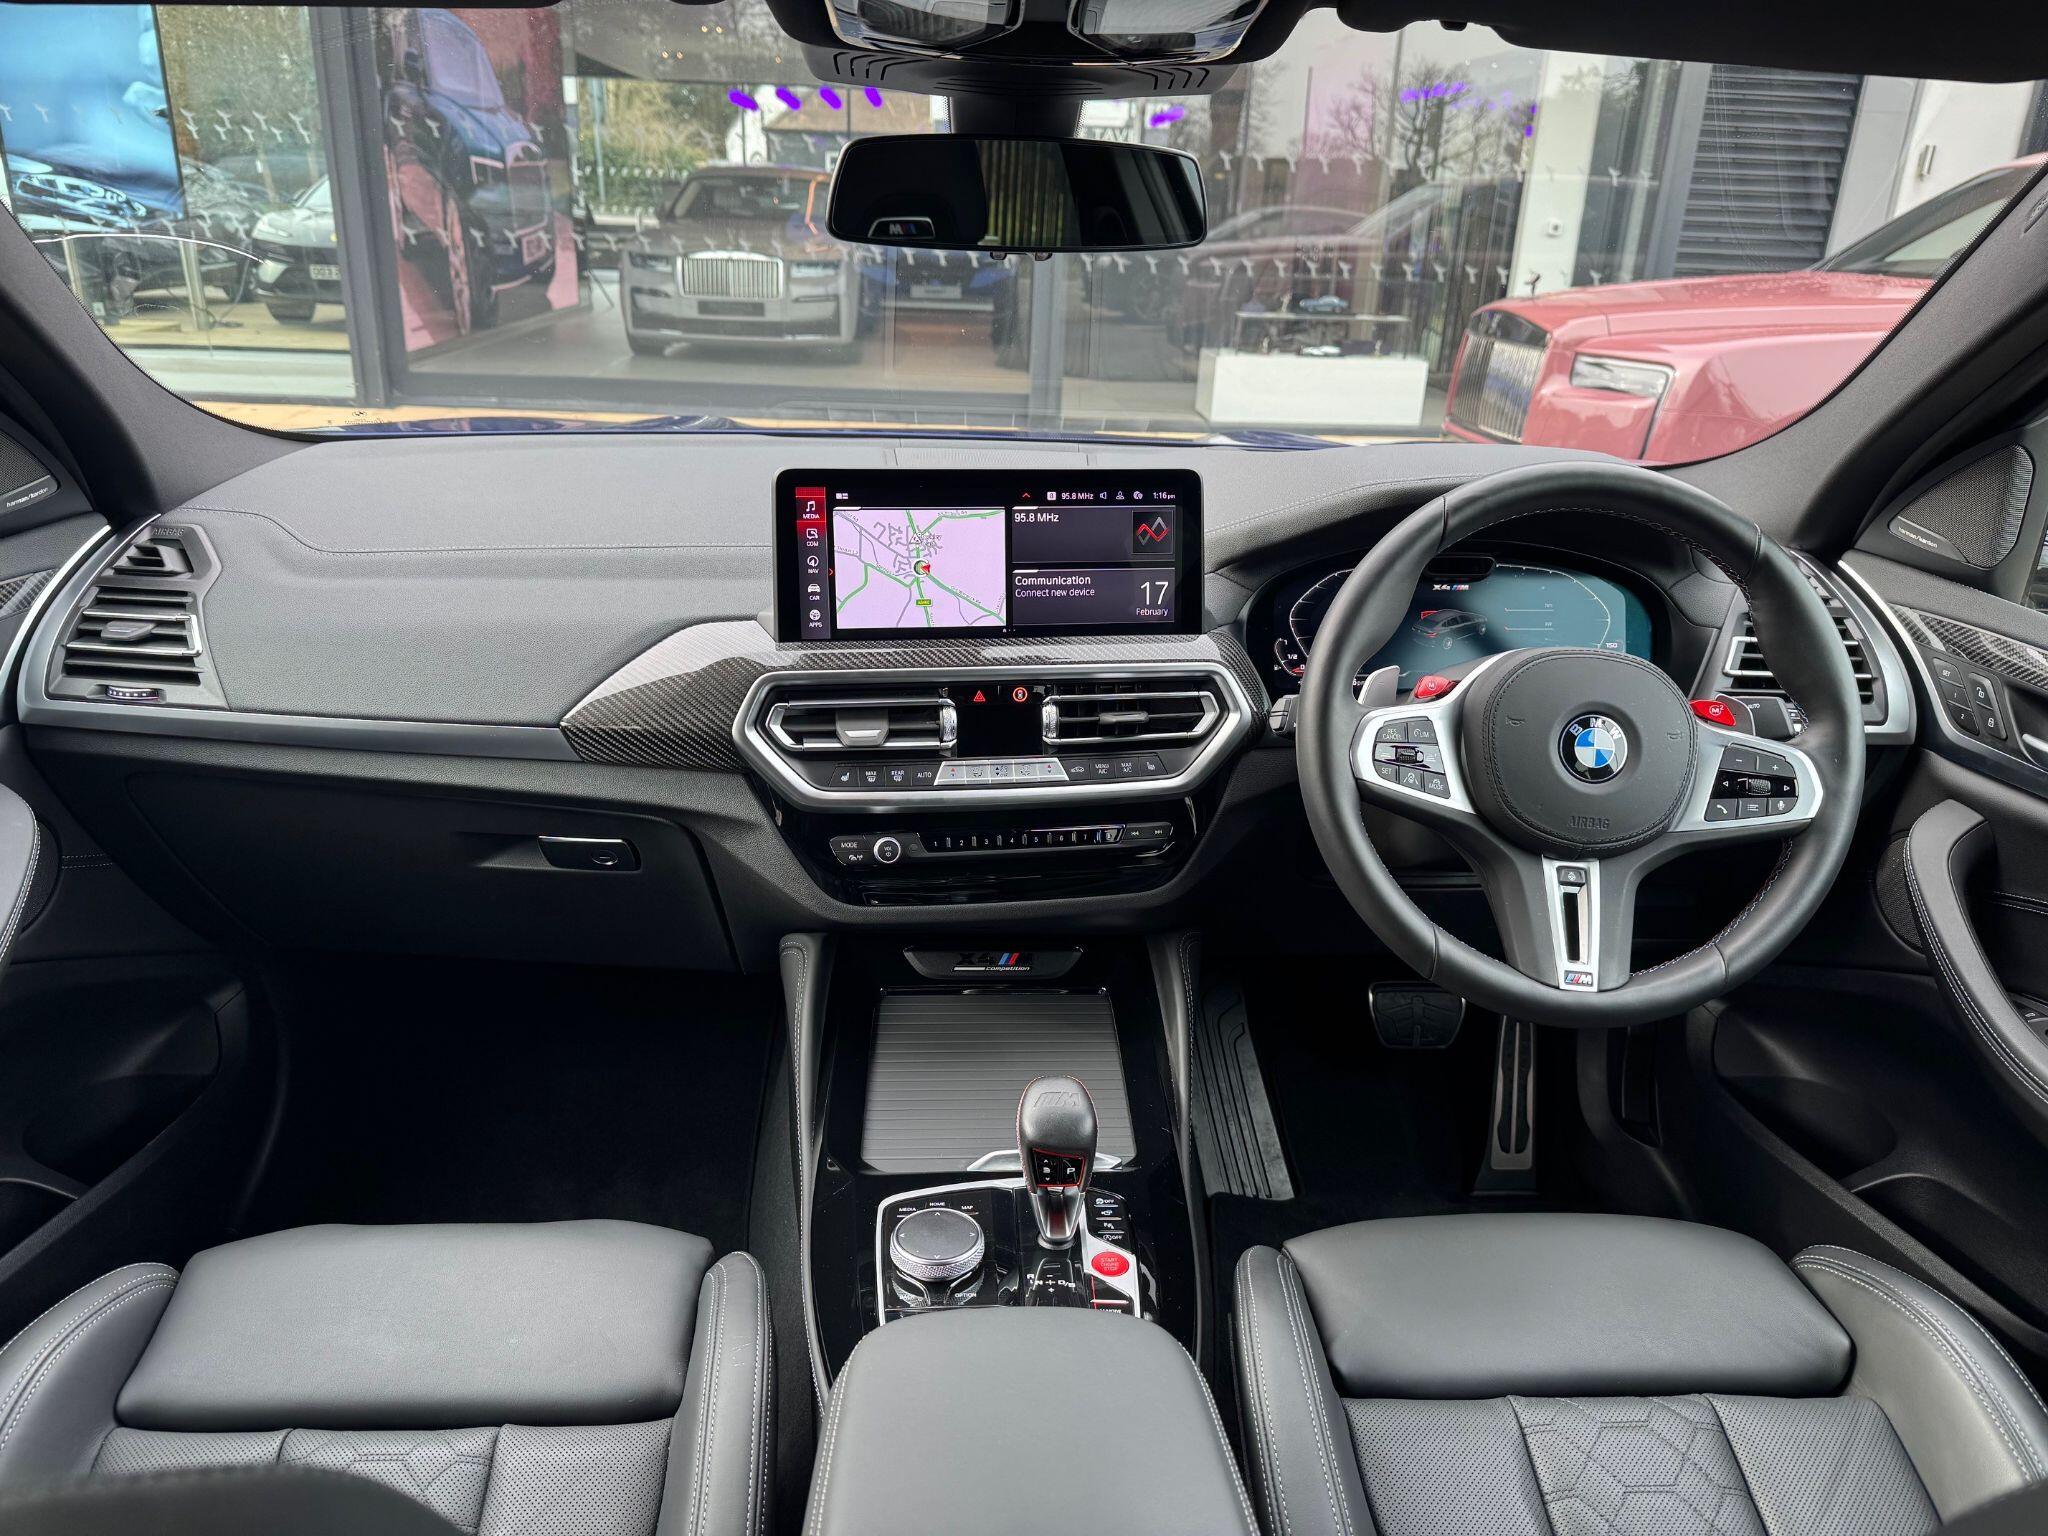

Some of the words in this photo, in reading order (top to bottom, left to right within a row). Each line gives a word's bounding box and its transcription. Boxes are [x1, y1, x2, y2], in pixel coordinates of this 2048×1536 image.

[1061, 491, 1077, 500] 95.8
[1077, 491, 1094, 500] MHz
[1014, 512, 1036, 523] 95.8
[1037, 512, 1060, 523] MHz
[806, 540, 819, 548] COM
[807, 567, 820, 575] NAV
[1015, 575, 1092, 586] Communication
[1015, 588, 1050, 598] Connect
[1051, 589, 1067, 598] new
[1069, 587, 1096, 597] device
[1140, 581, 1170, 606] 17
[809, 594, 820, 602] CAR
[1135, 607, 1169, 617] February
[808, 621, 823, 629] APPS
[1569, 717, 1622, 740] BMW
[1381, 767, 1392, 775] SET
[1567, 815, 1611, 830] AIRBAG
[840, 841, 858, 849] MODE
[1066, 1167, 1076, 1175] P
